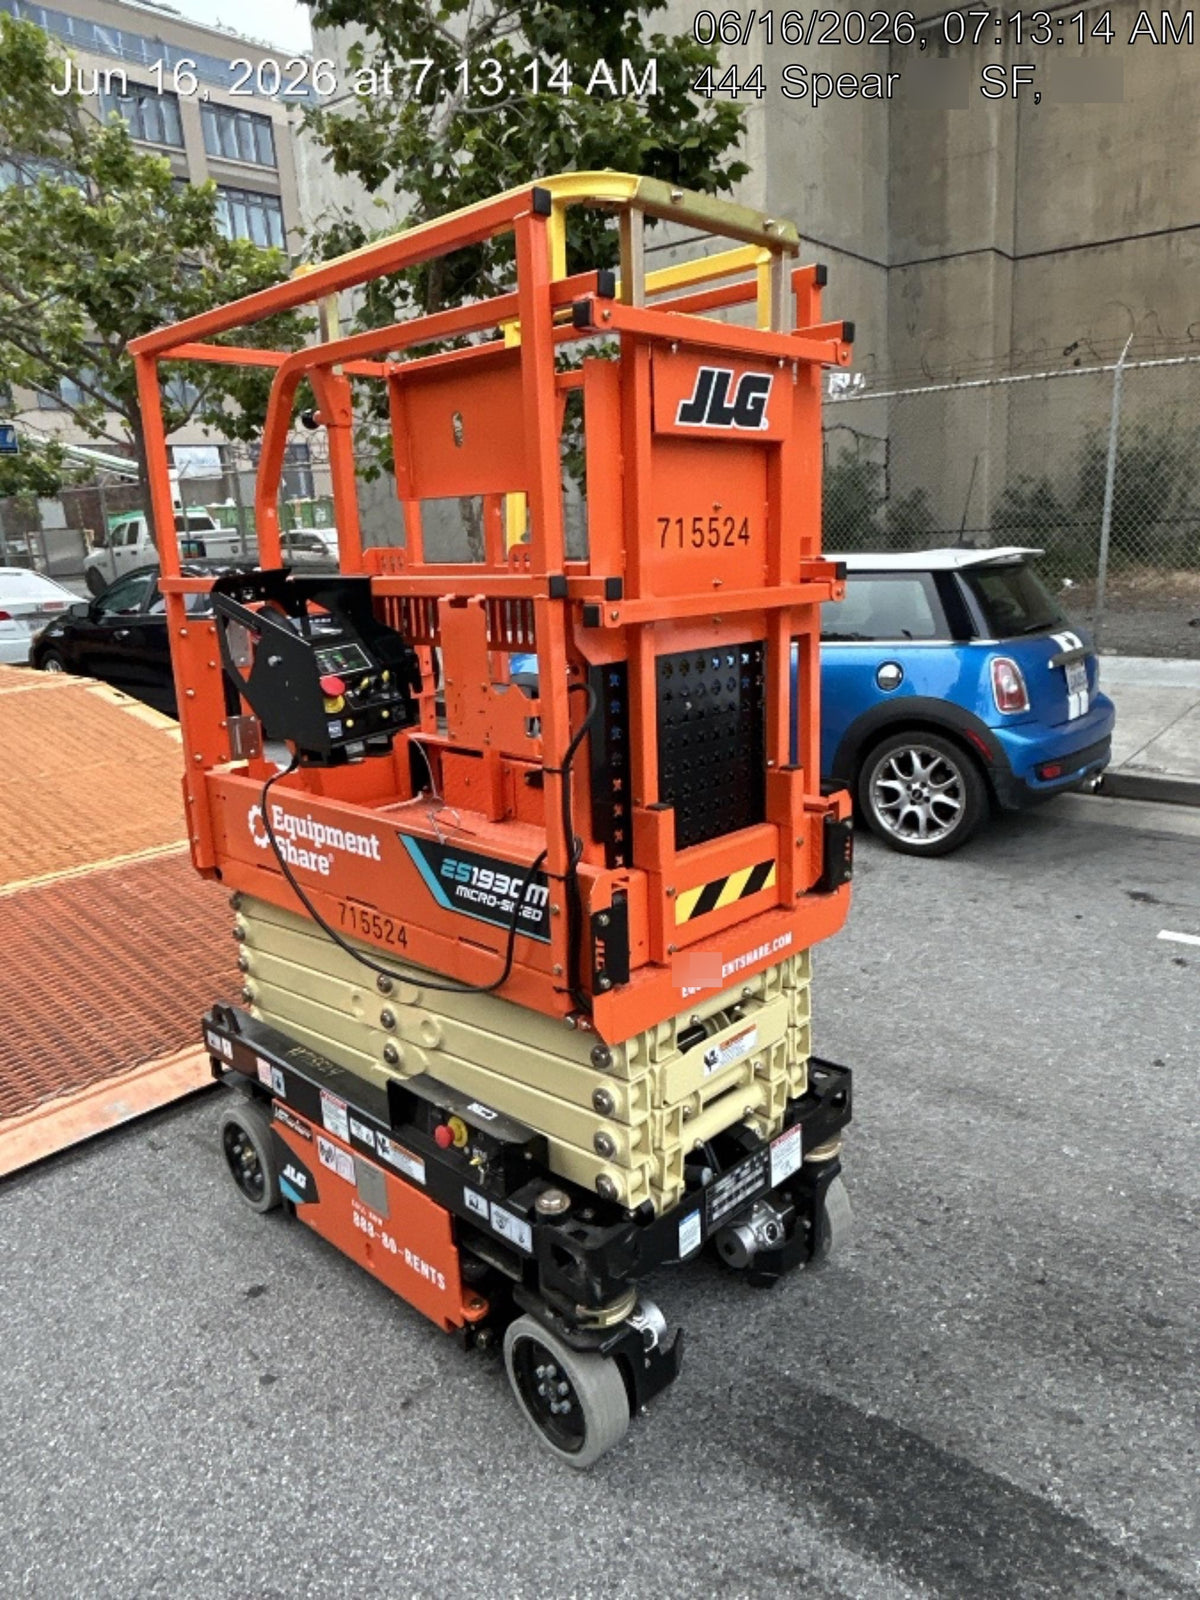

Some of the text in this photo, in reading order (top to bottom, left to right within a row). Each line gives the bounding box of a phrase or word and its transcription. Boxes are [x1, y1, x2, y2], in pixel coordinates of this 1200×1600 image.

[676, 367, 773, 430] JLG
[657, 517, 750, 549] 715524
[271, 804, 382, 861] Equipment
[337, 902, 409, 949] 715524
[456, 885, 543, 921] MICRO-SIED
